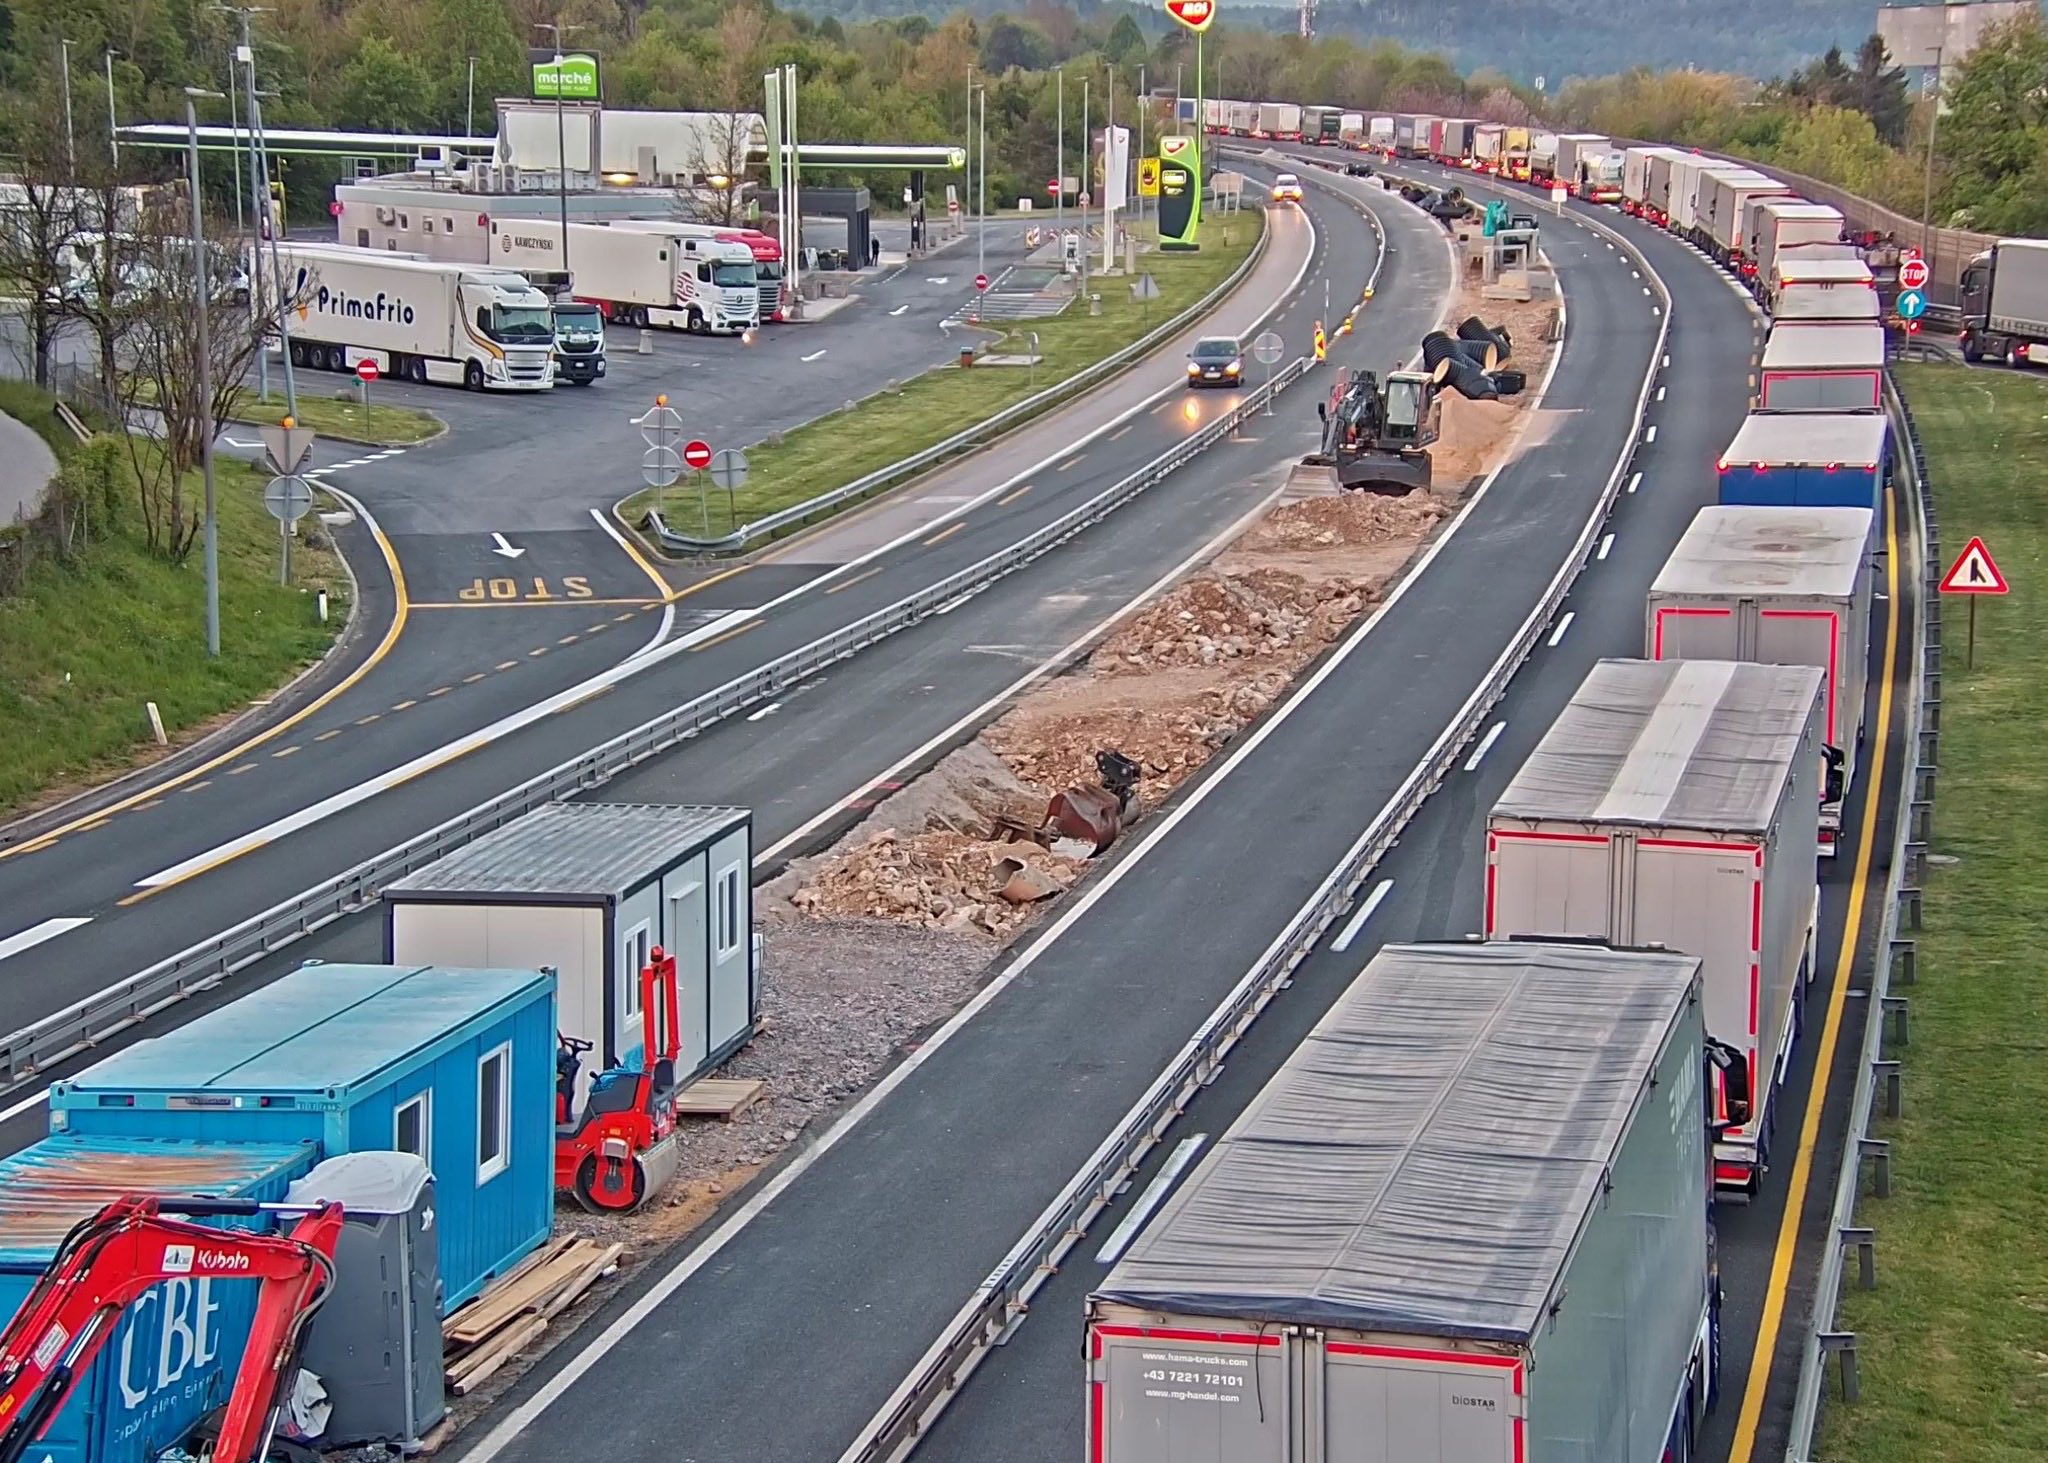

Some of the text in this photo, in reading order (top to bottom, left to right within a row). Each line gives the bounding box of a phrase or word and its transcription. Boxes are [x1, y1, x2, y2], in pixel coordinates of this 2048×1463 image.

[1182, 1, 1208, 16] MOL
[537, 72, 592, 85] marché
[1903, 268, 1927, 280] STOP
[459, 576, 593, 600] STOP
[198, 1249, 249, 1269] Kubota
[119, 1276, 219, 1409] CBE
[1142, 1353, 1248, 1367] www.hama-trucks.com
[1143, 1370, 1243, 1386] +43 7221 72101
[1145, 1389, 1240, 1402] www.mg-handel.com
